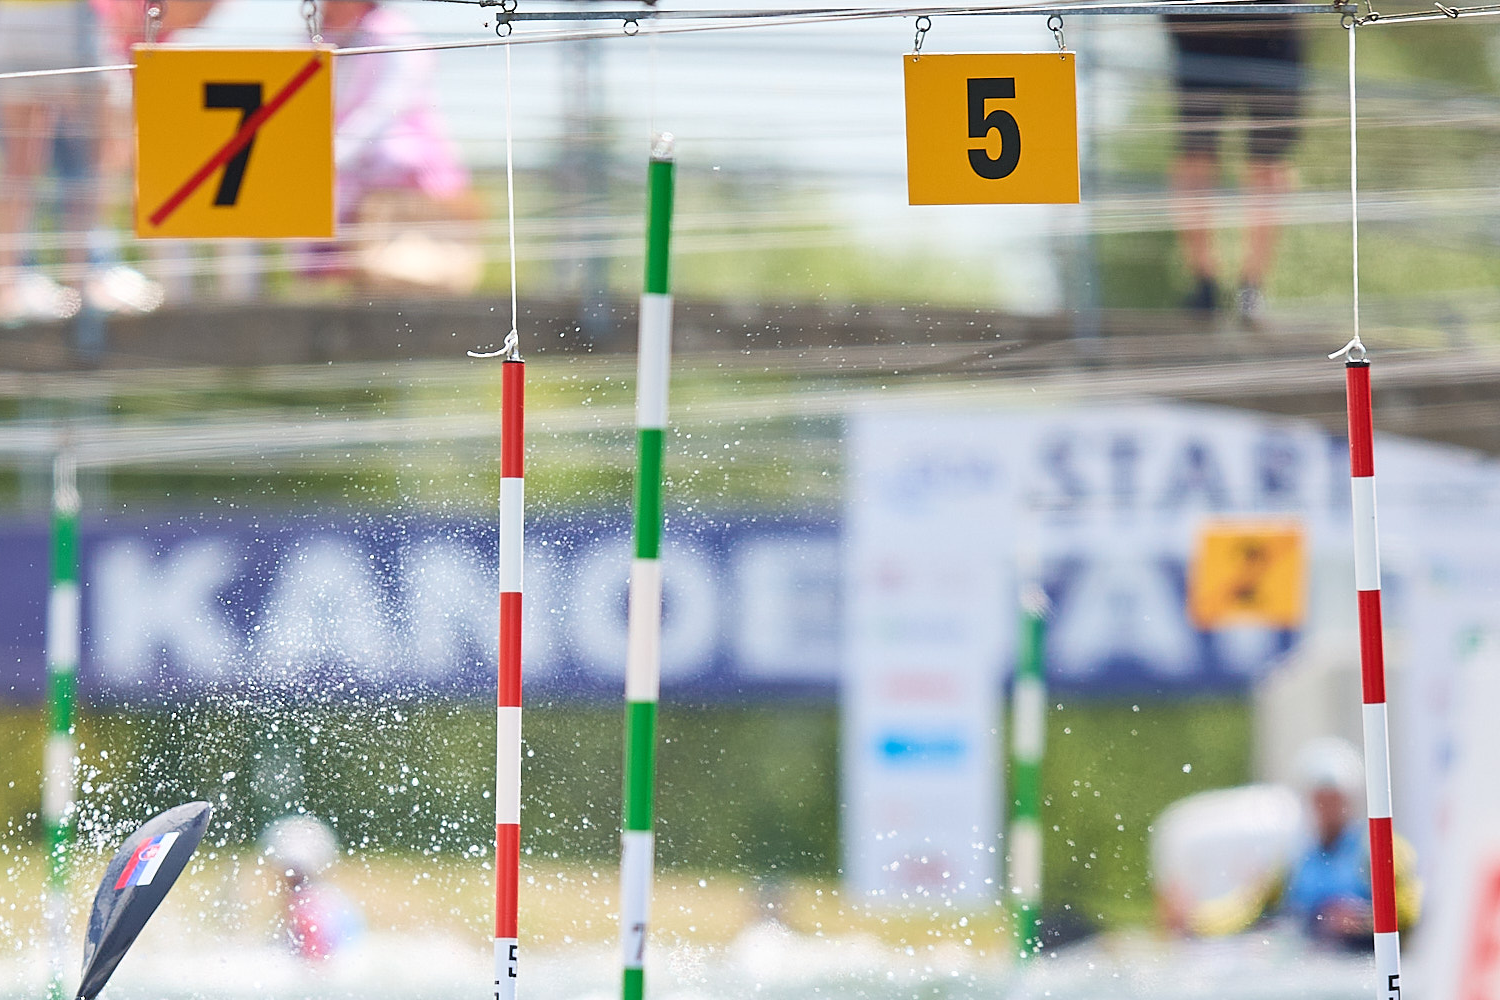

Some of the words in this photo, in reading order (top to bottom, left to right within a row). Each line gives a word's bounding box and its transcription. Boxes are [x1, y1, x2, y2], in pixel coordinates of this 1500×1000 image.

[202, 82, 263, 207] 7
[966, 77, 1022, 180] 5
[90, 533, 843, 687] KANOE
